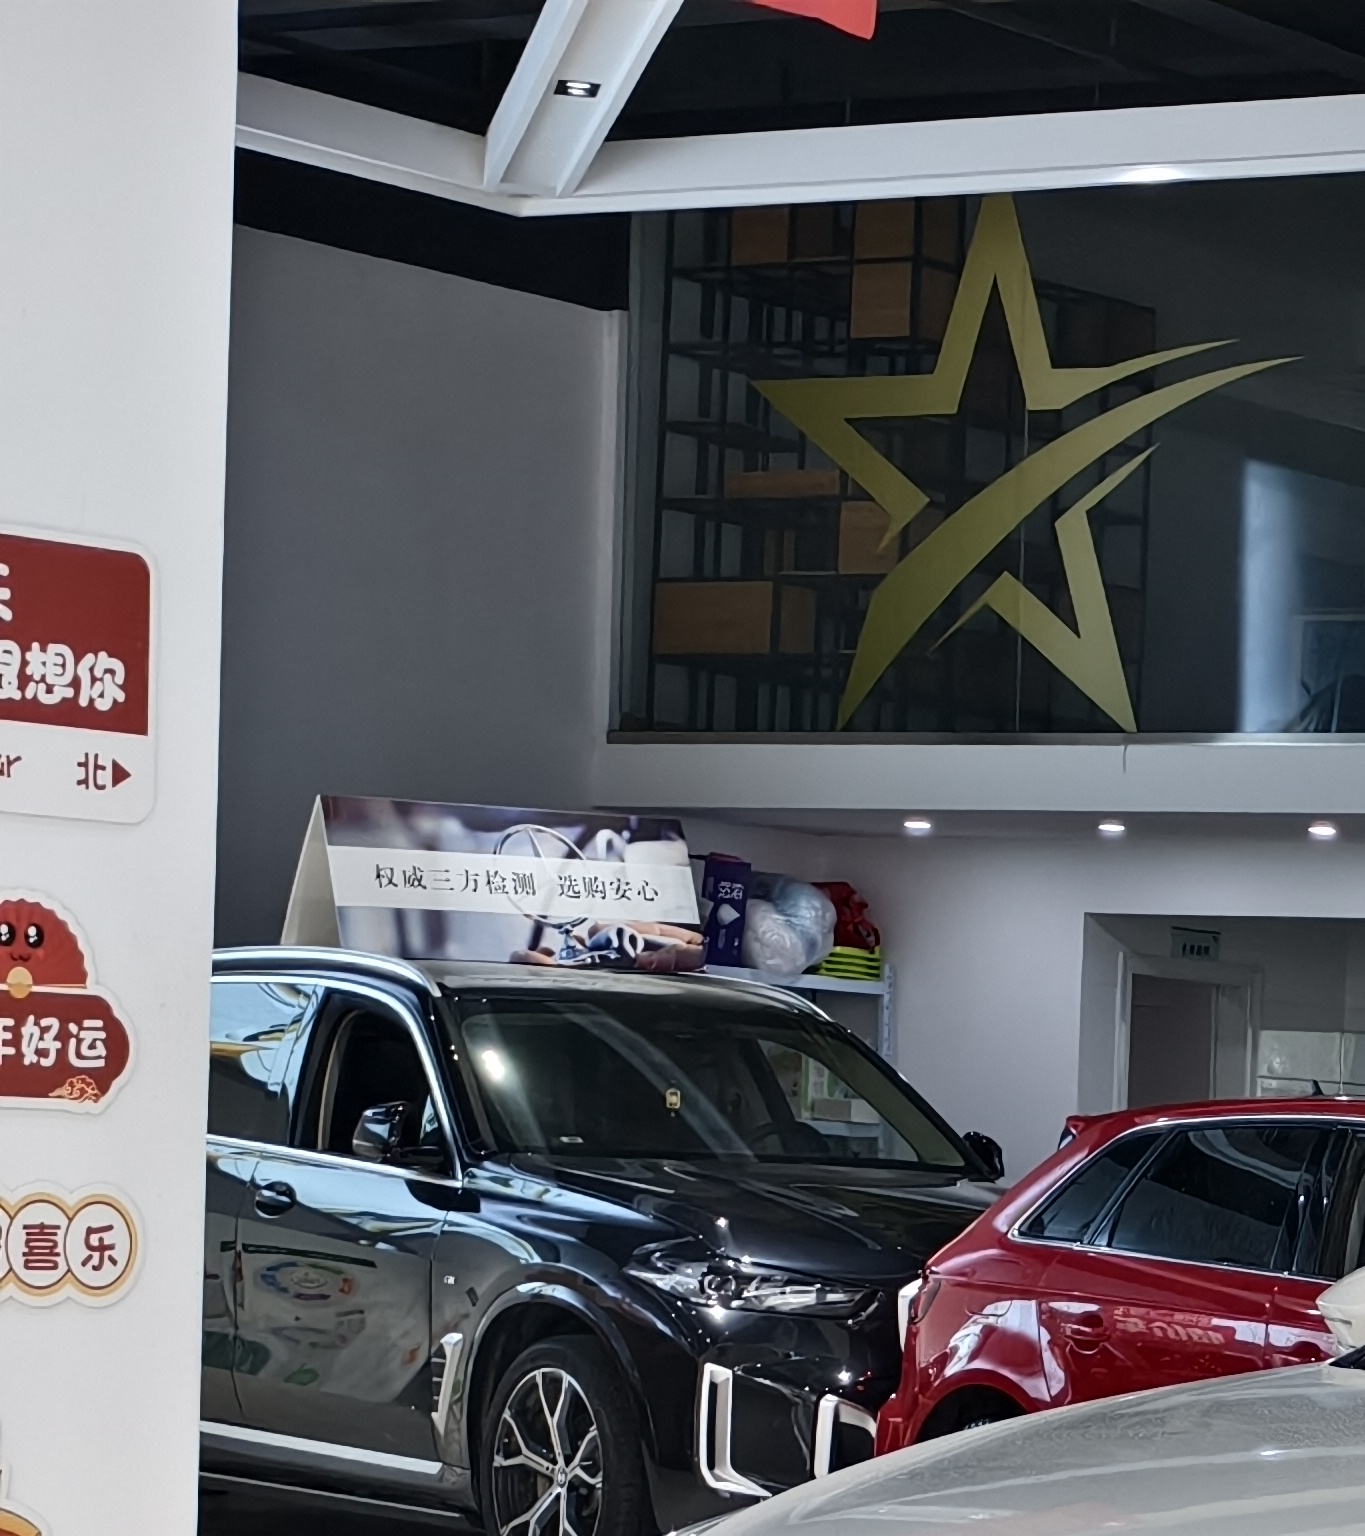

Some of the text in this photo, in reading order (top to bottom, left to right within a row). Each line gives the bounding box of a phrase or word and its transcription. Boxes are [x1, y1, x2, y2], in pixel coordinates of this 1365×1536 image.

[76, 752, 107, 791] 北
[375, 863, 660, 902] 权威三方检测 选购安心
